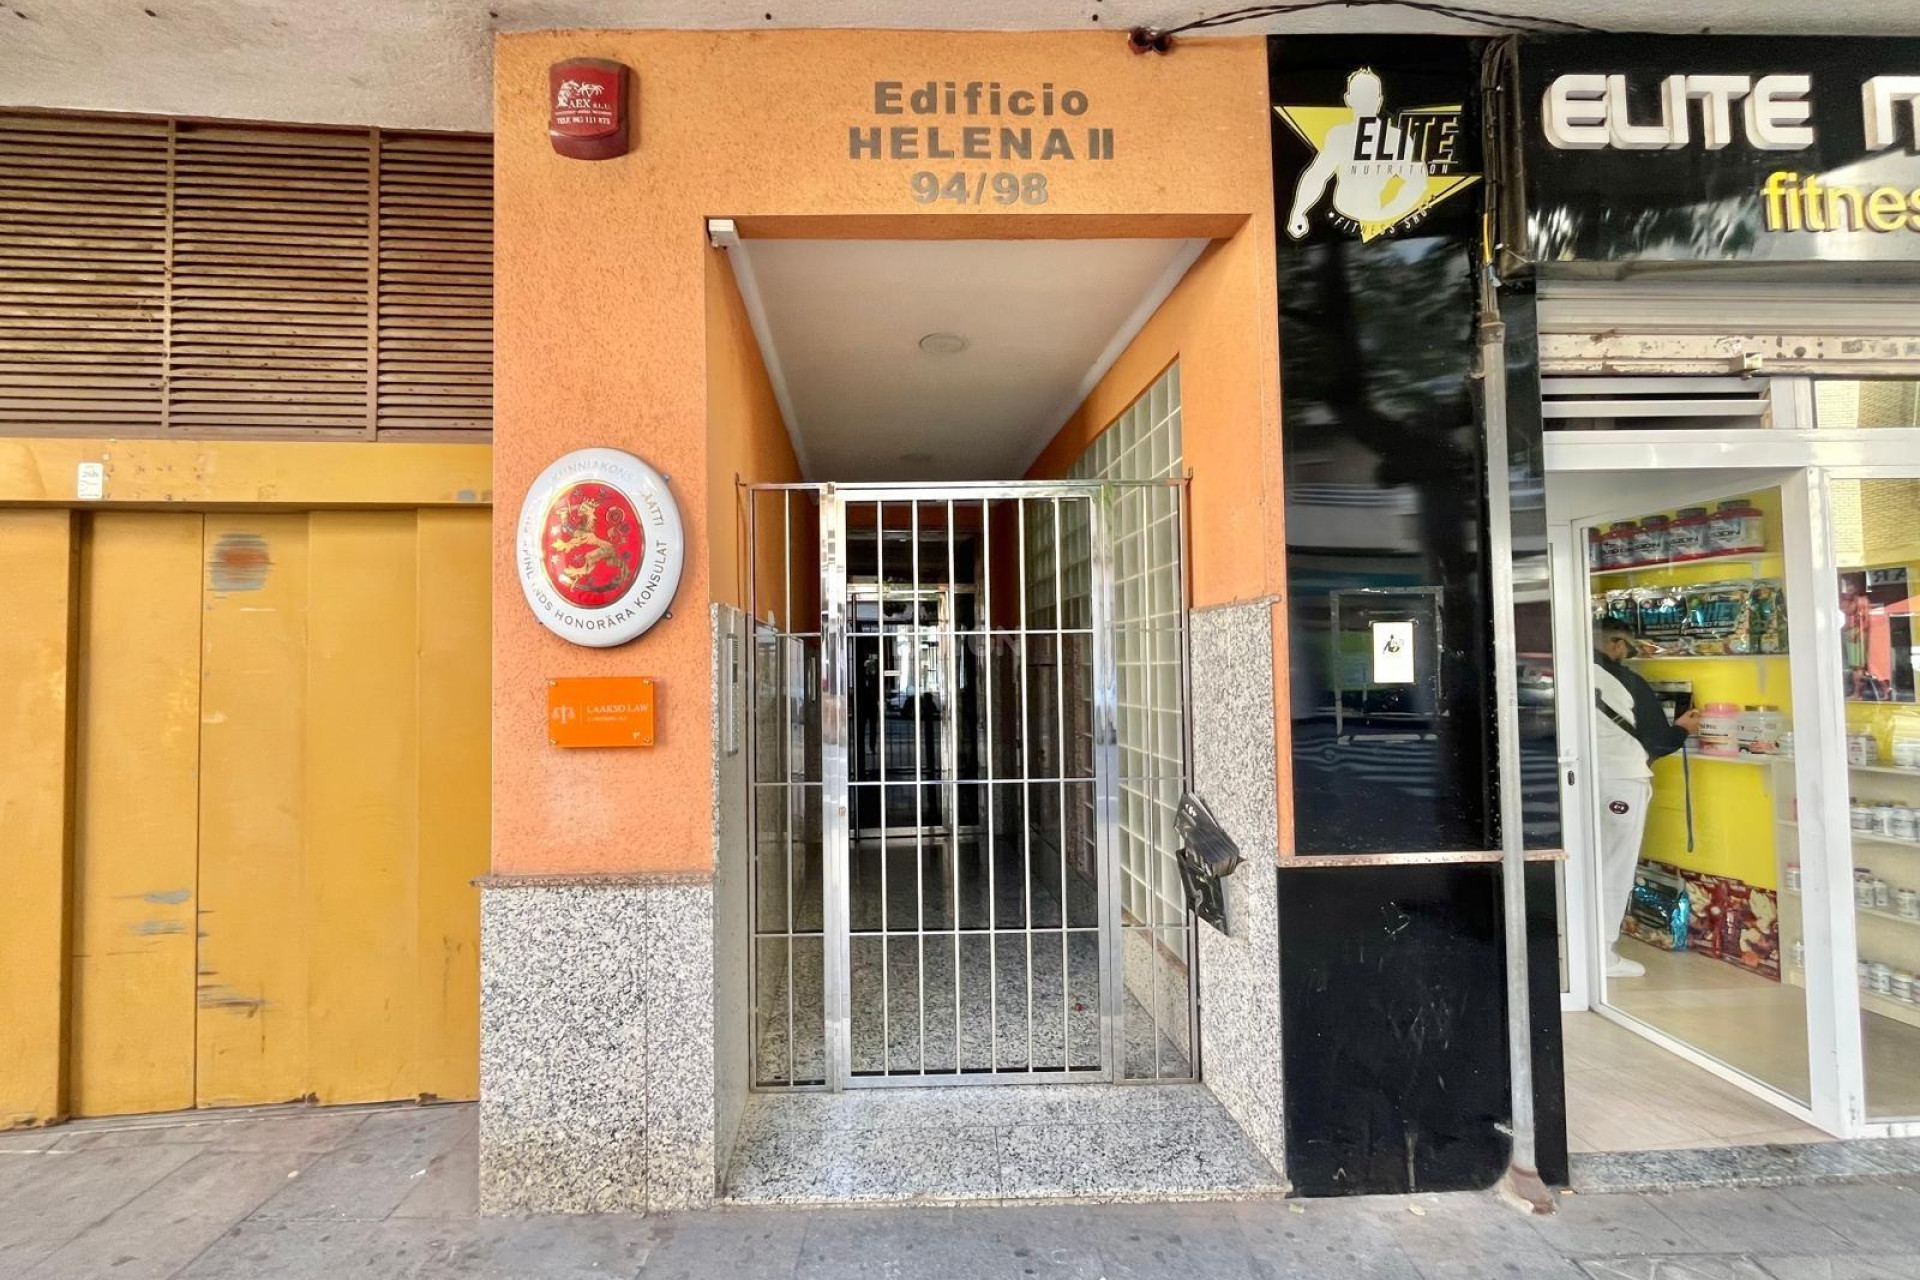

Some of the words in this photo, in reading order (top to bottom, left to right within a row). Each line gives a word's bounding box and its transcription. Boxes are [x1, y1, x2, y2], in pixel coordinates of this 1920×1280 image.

[874, 81, 1089, 116] Edificio
[1542, 74, 1814, 150] ELITE
[849, 126, 1075, 160] HELENA
[1353, 114, 1459, 163] ELITE
[1351, 164, 1449, 175] NUTRITION
[911, 171, 1049, 205] 94/98
[1334, 217, 1395, 236] FITNESS
[554, 608, 636, 630] HONORÄRA
[634, 541, 668, 608] KONSULAT
[627, 704, 649, 713] LAW
